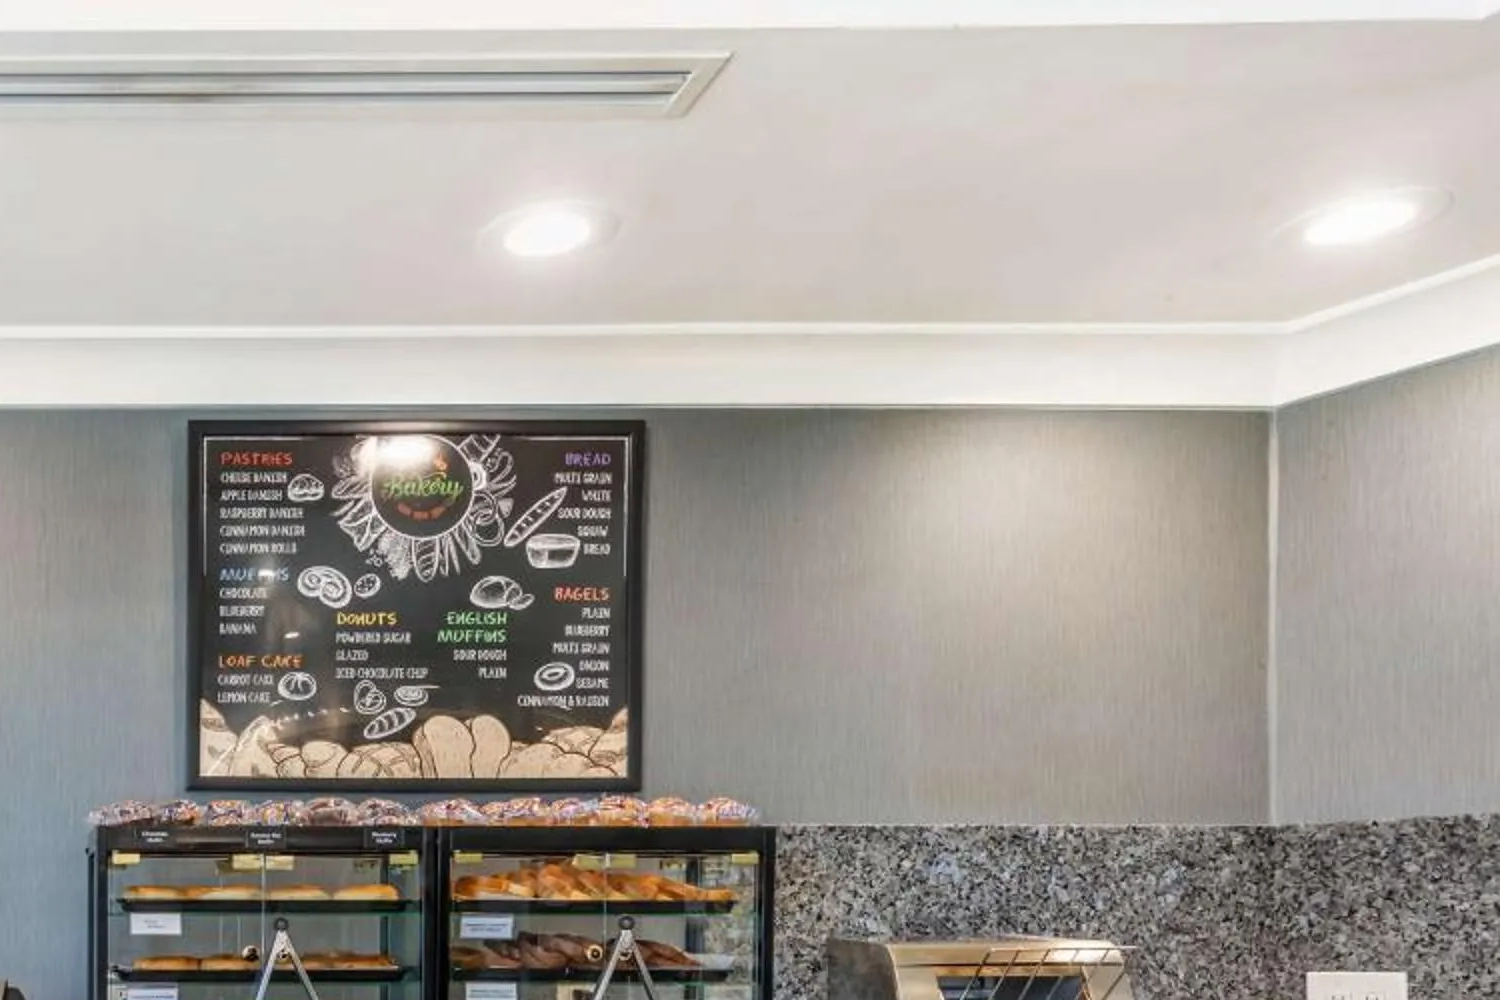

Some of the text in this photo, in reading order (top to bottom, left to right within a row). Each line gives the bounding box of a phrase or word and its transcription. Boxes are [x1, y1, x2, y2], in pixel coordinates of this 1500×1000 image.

[220, 452, 293, 466] PASTRIES
[565, 452, 611, 466] BREAD
[254, 471, 288, 483] DANISH
[583, 472, 612, 484] GRAIN
[221, 489, 283, 500] APPLE DANISH
[582, 489, 612, 501] WHITE
[220, 507, 304, 519] RASPBERRY DANISH
[558, 507, 612, 519] SOUR DOUGH
[220, 525, 305, 536] CINNAMON DANISH
[220, 542, 297, 554] CINNAMON ROLLS
[583, 543, 611, 555] BREAD
[220, 587, 268, 599] CHOCOLATE
[555, 587, 610, 601] BAGELS
[336, 611, 397, 625] DONUTS
[446, 611, 508, 625] ENGLISH
[581, 607, 611, 619] PLAIN
[437, 629, 508, 643] MUFFINS
[564, 624, 611, 637] BLUEBERRY
[383, 631, 412, 643] SUGAR
[552, 642, 610, 654] MULTI GRAIN
[335, 649, 369, 661] GLAZED
[453, 649, 507, 661] SOUR DOUGH
[218, 655, 303, 668] LOAF CAKE
[253, 673, 274, 685] CAKE
[357, 667, 405, 679] CHOCOLATE
[406, 667, 429, 679] CHIP
[478, 667, 507, 679] PLAIN
[575, 677, 609, 689] SESAME
[217, 691, 271, 703] LEMON CAKE
